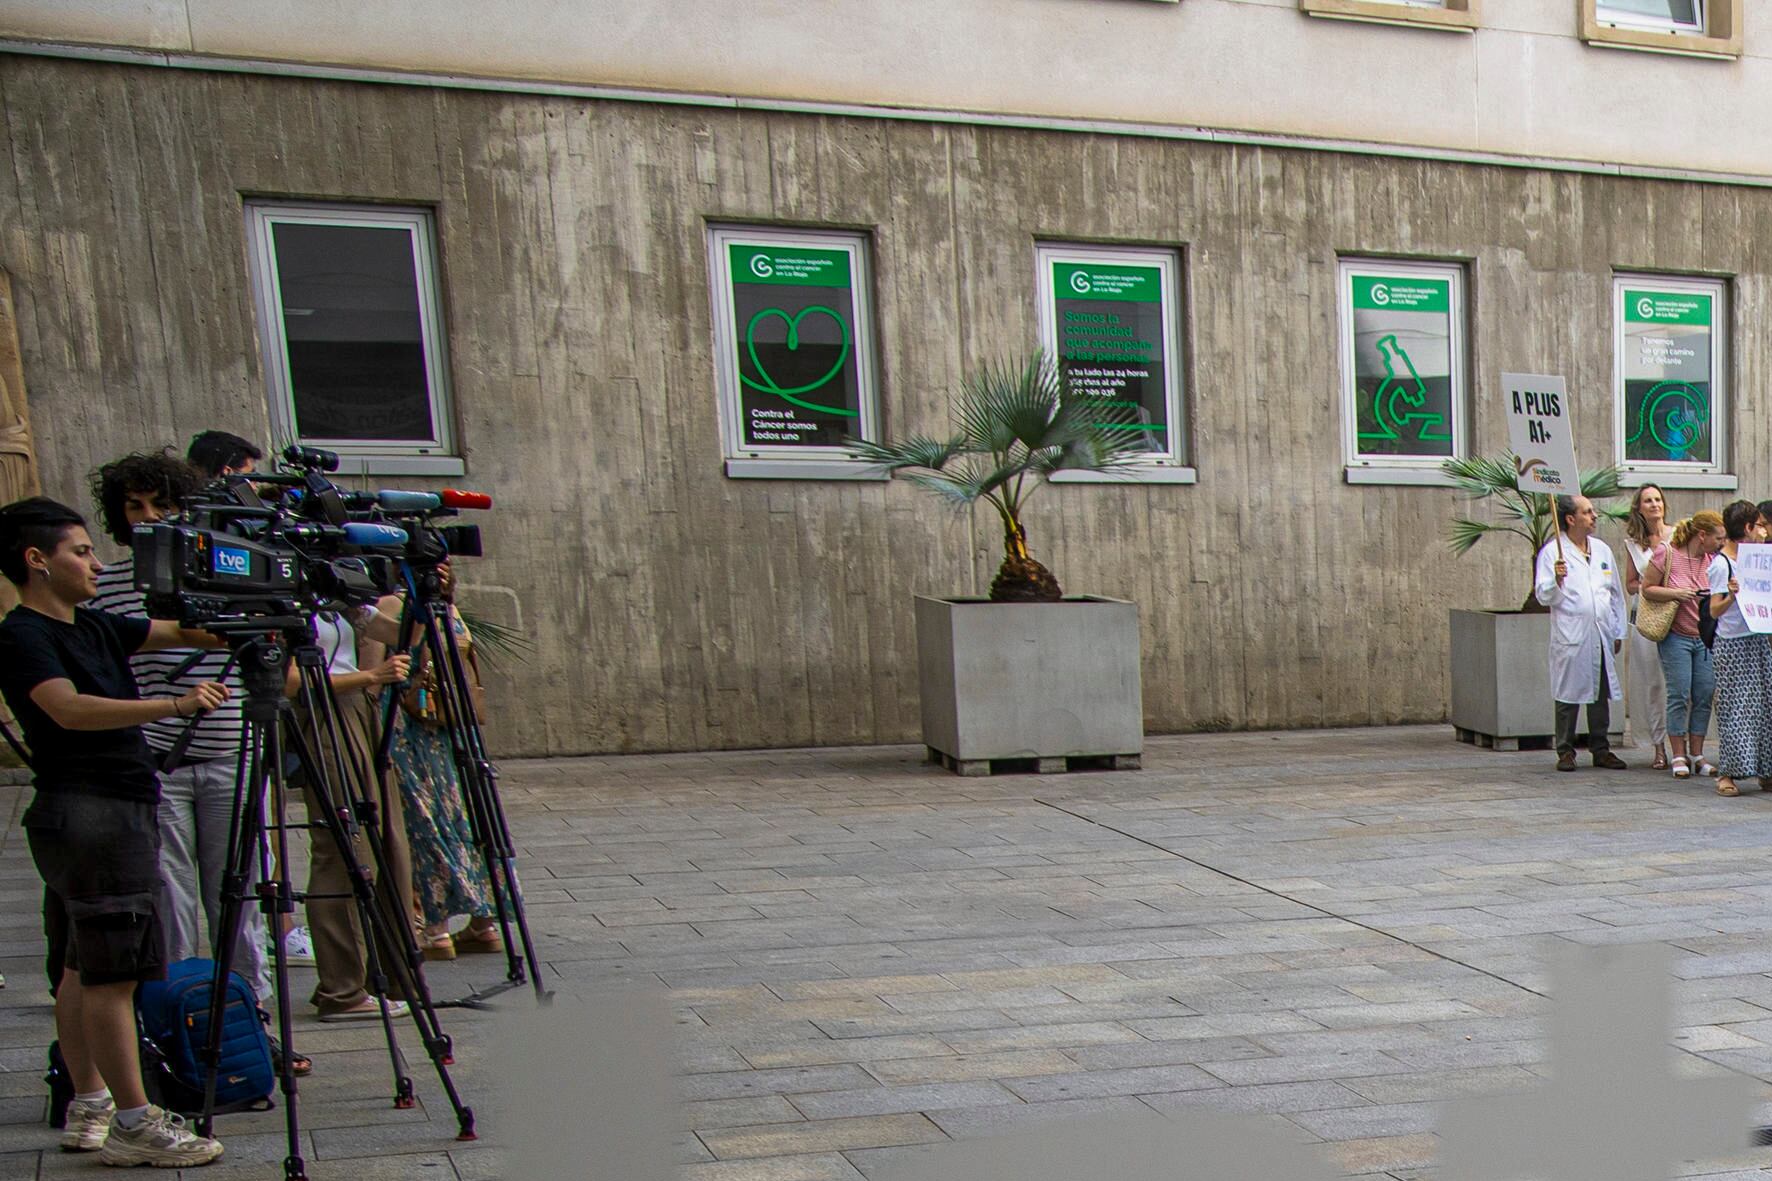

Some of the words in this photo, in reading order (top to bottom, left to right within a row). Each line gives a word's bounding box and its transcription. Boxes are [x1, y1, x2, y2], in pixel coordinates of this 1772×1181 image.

[1065, 311, 1104, 324] Somos
[1107, 313, 1120, 324] la
[1066, 326, 1133, 338] comunidad
[1066, 338, 1089, 349] que
[1076, 350, 1093, 361] las
[1096, 352, 1151, 364] personas
[1084, 368, 1102, 376] lado
[1102, 368, 1115, 376] las
[1126, 369, 1149, 378] horas
[1110, 379, 1126, 387] año
[1512, 390, 1523, 414] A
[1524, 392, 1561, 418] PLUS
[751, 409, 784, 418] Contra
[784, 410, 795, 419] el
[786, 422, 818, 430] somos
[1528, 420, 1552, 444] A1+
[752, 431, 780, 440] todos
[218, 550, 246, 572] tve
[281, 564, 292, 578] 5
